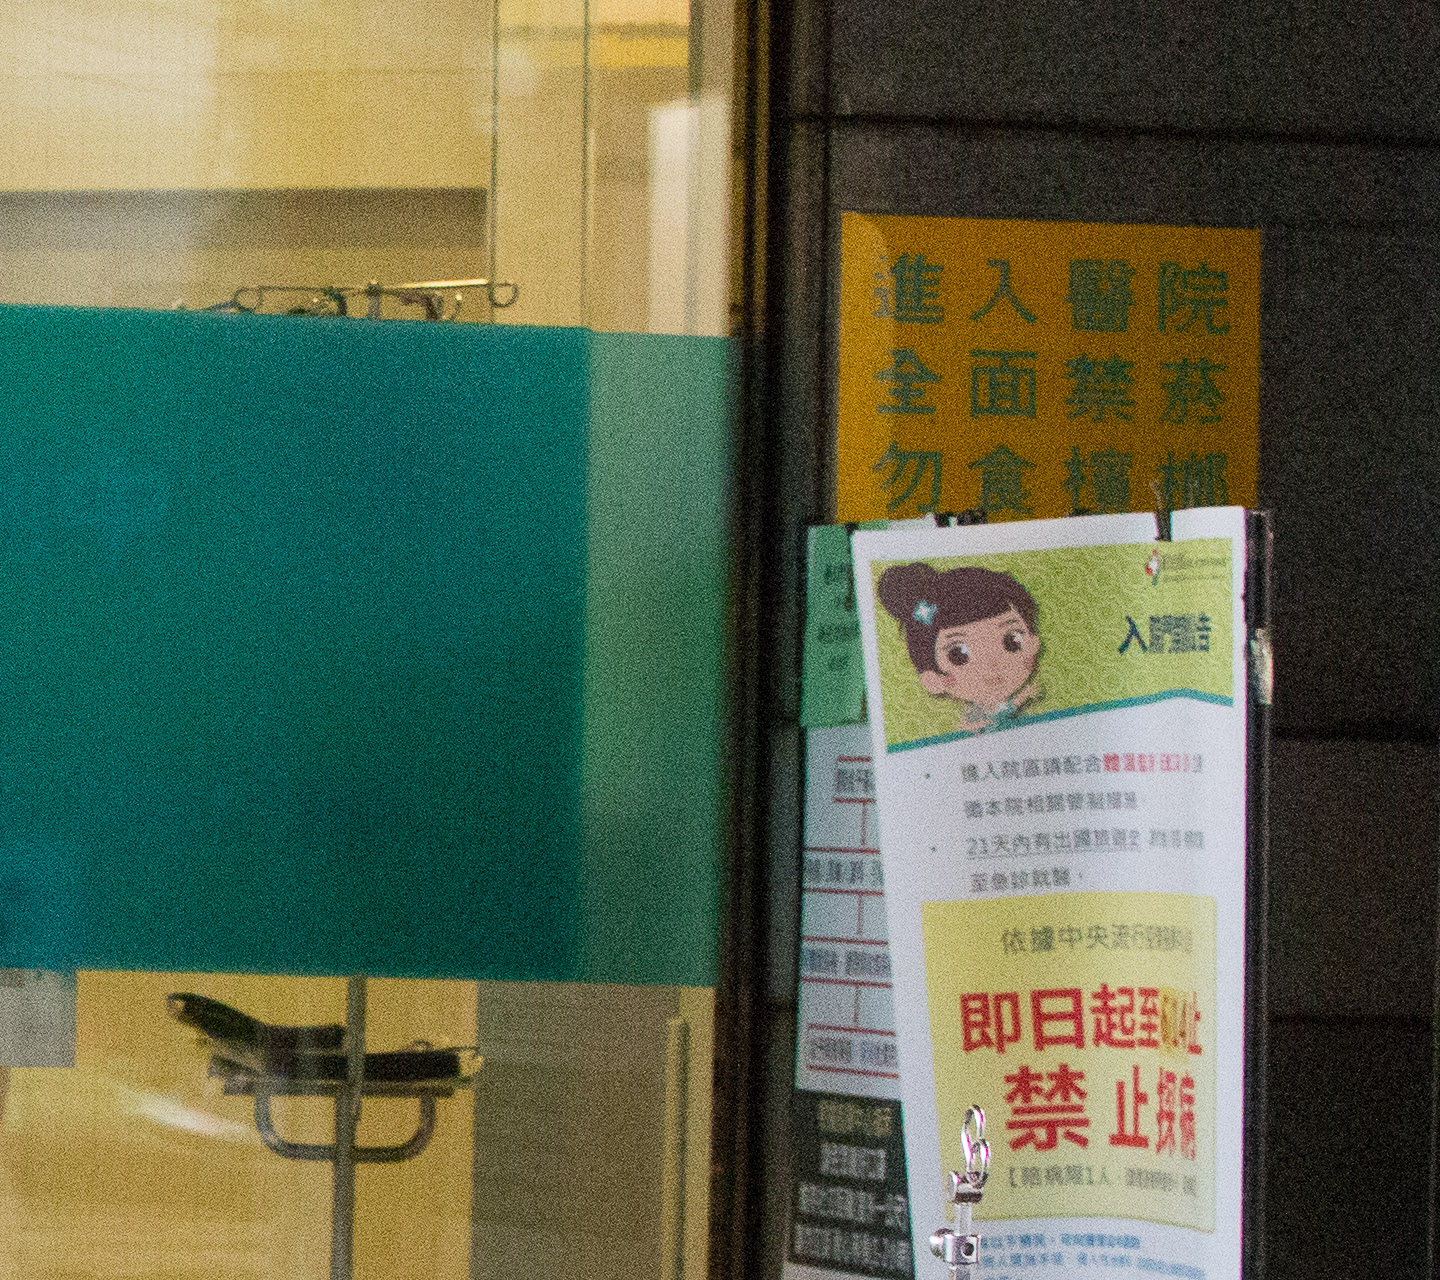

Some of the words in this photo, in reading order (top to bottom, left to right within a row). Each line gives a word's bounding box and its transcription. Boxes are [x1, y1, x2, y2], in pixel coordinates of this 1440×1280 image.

[871, 252, 1231, 336] 進入醫院
[872, 347, 1229, 426] 全面禁菸
[871, 440, 1231, 518] 勿食檳榔
